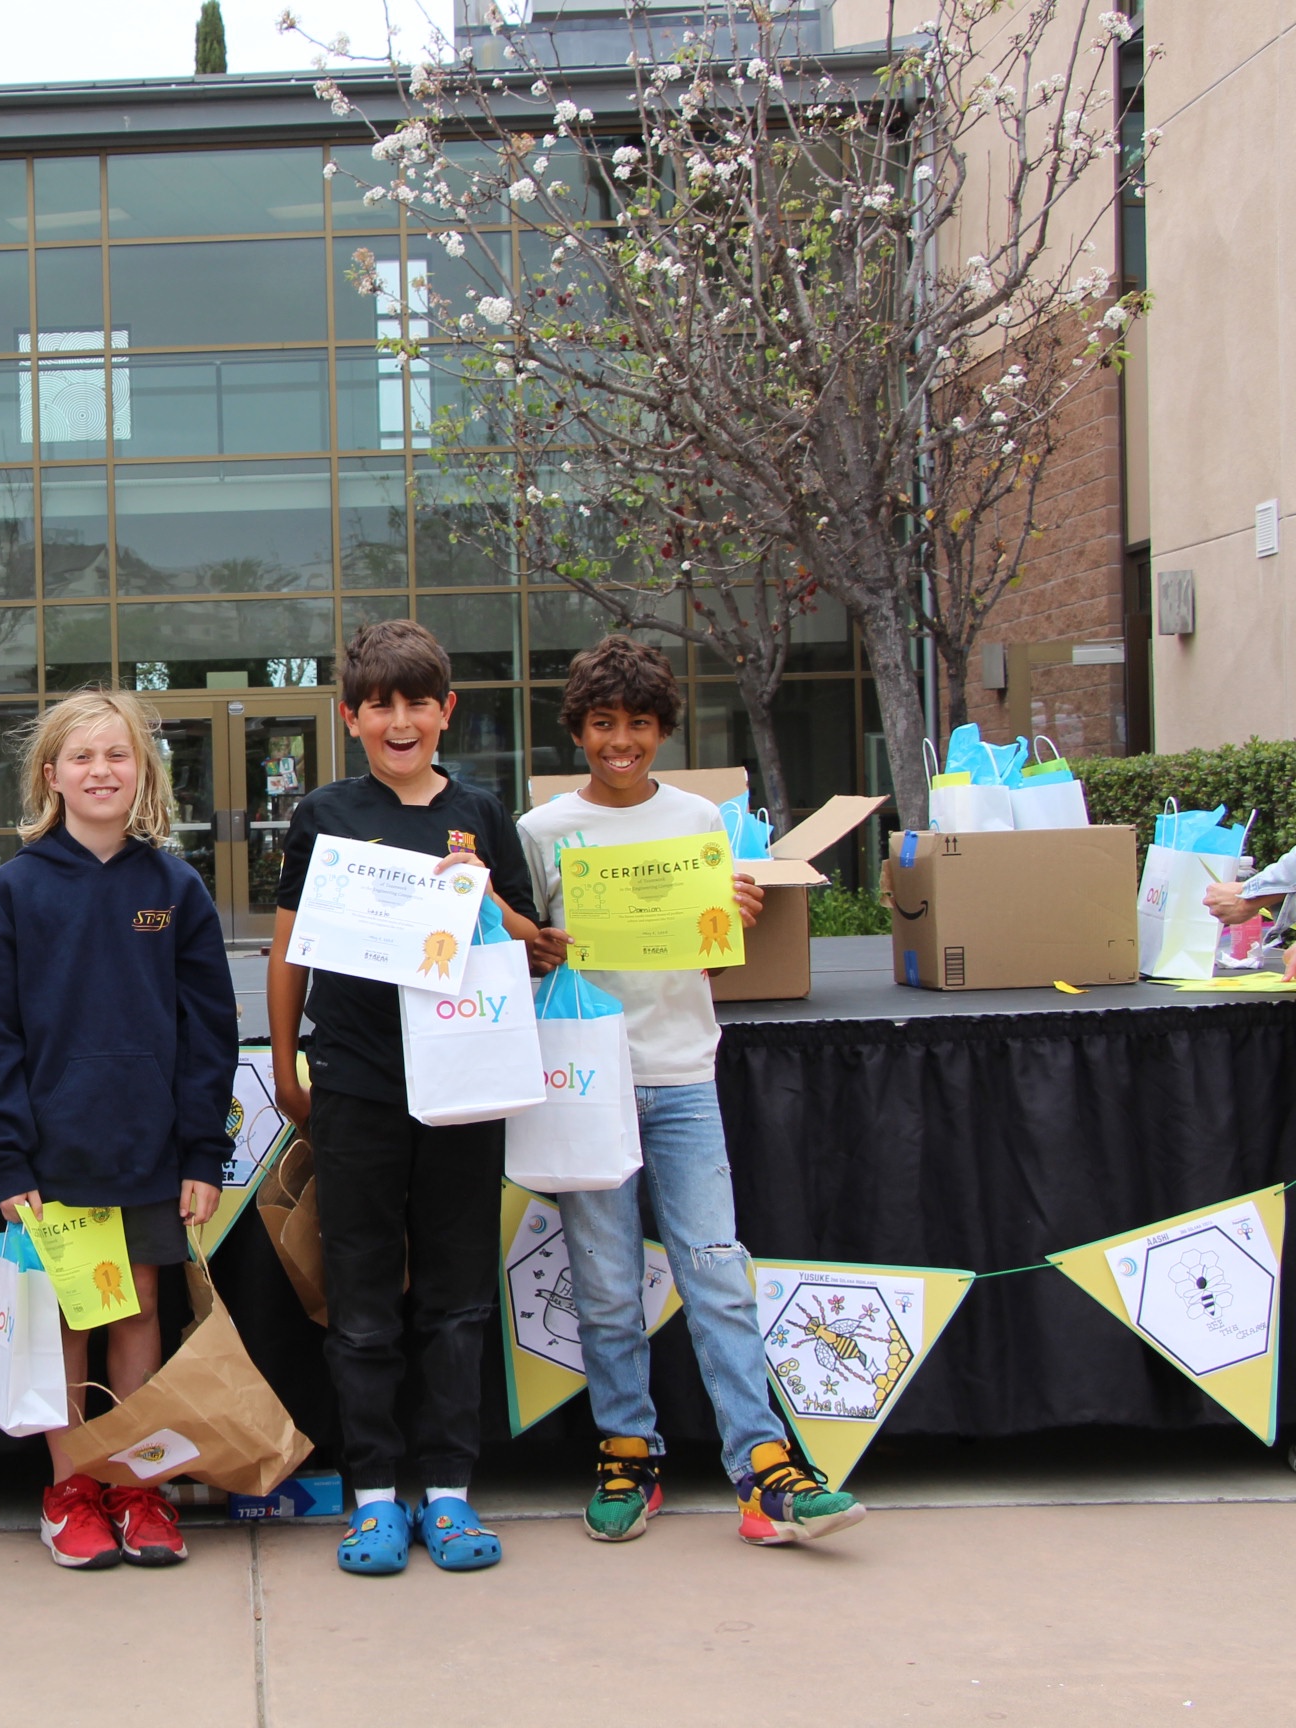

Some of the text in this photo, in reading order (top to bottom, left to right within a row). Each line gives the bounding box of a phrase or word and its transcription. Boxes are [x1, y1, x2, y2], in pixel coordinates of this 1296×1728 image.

[347, 863, 447, 891] CERTIFICATE
[600, 858, 701, 879] CERTIFICATE
[1146, 884, 1169, 912] ooly
[709, 915, 719, 934] 1
[435, 939, 445, 957] 1
[436, 990, 508, 1023] ooly
[1146, 1232, 1170, 1247] AASHI
[798, 1272, 831, 1283] YUSUKE
